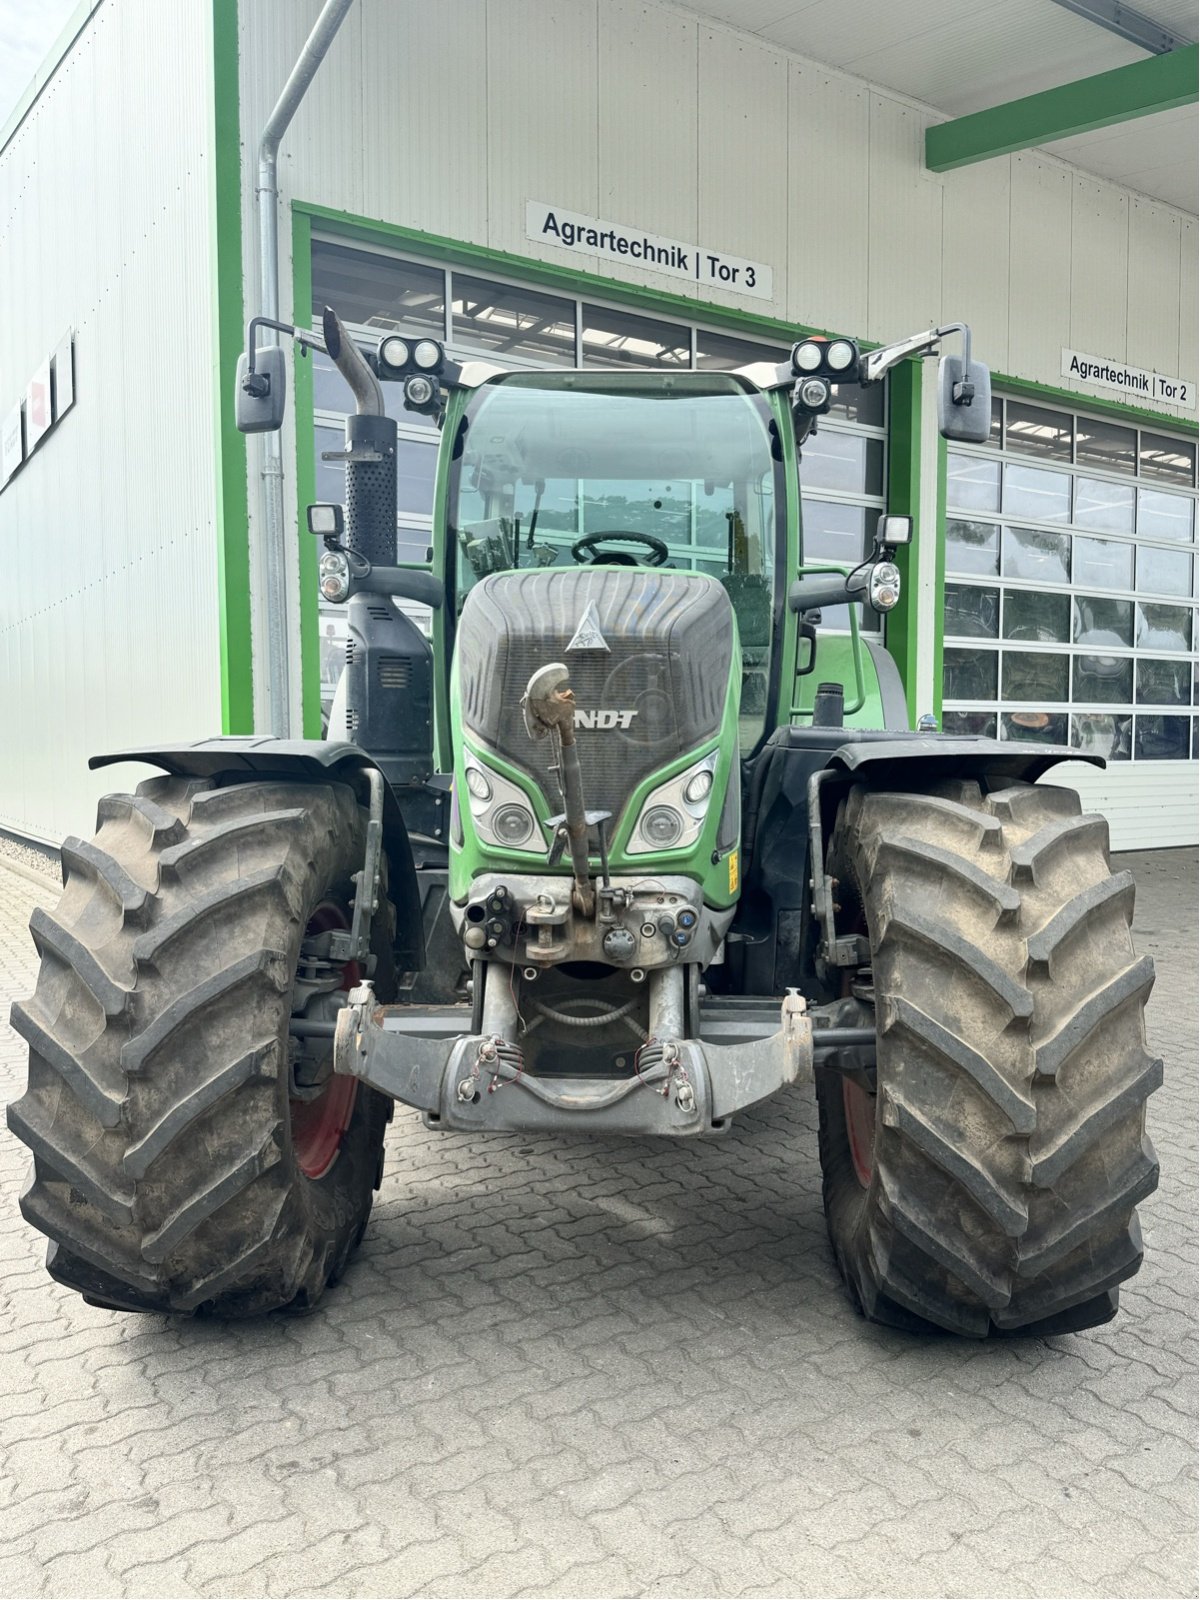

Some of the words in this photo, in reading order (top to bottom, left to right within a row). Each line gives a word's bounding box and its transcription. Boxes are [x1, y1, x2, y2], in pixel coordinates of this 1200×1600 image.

[542, 212, 688, 270] Agrartechnik
[706, 255, 740, 283] Tor
[745, 266, 756, 288] 3
[1070, 355, 1149, 391] Agrartechnik
[1159, 379, 1178, 399] Tor
[1180, 385, 1187, 401] 2
[573, 709, 639, 729] NDT
